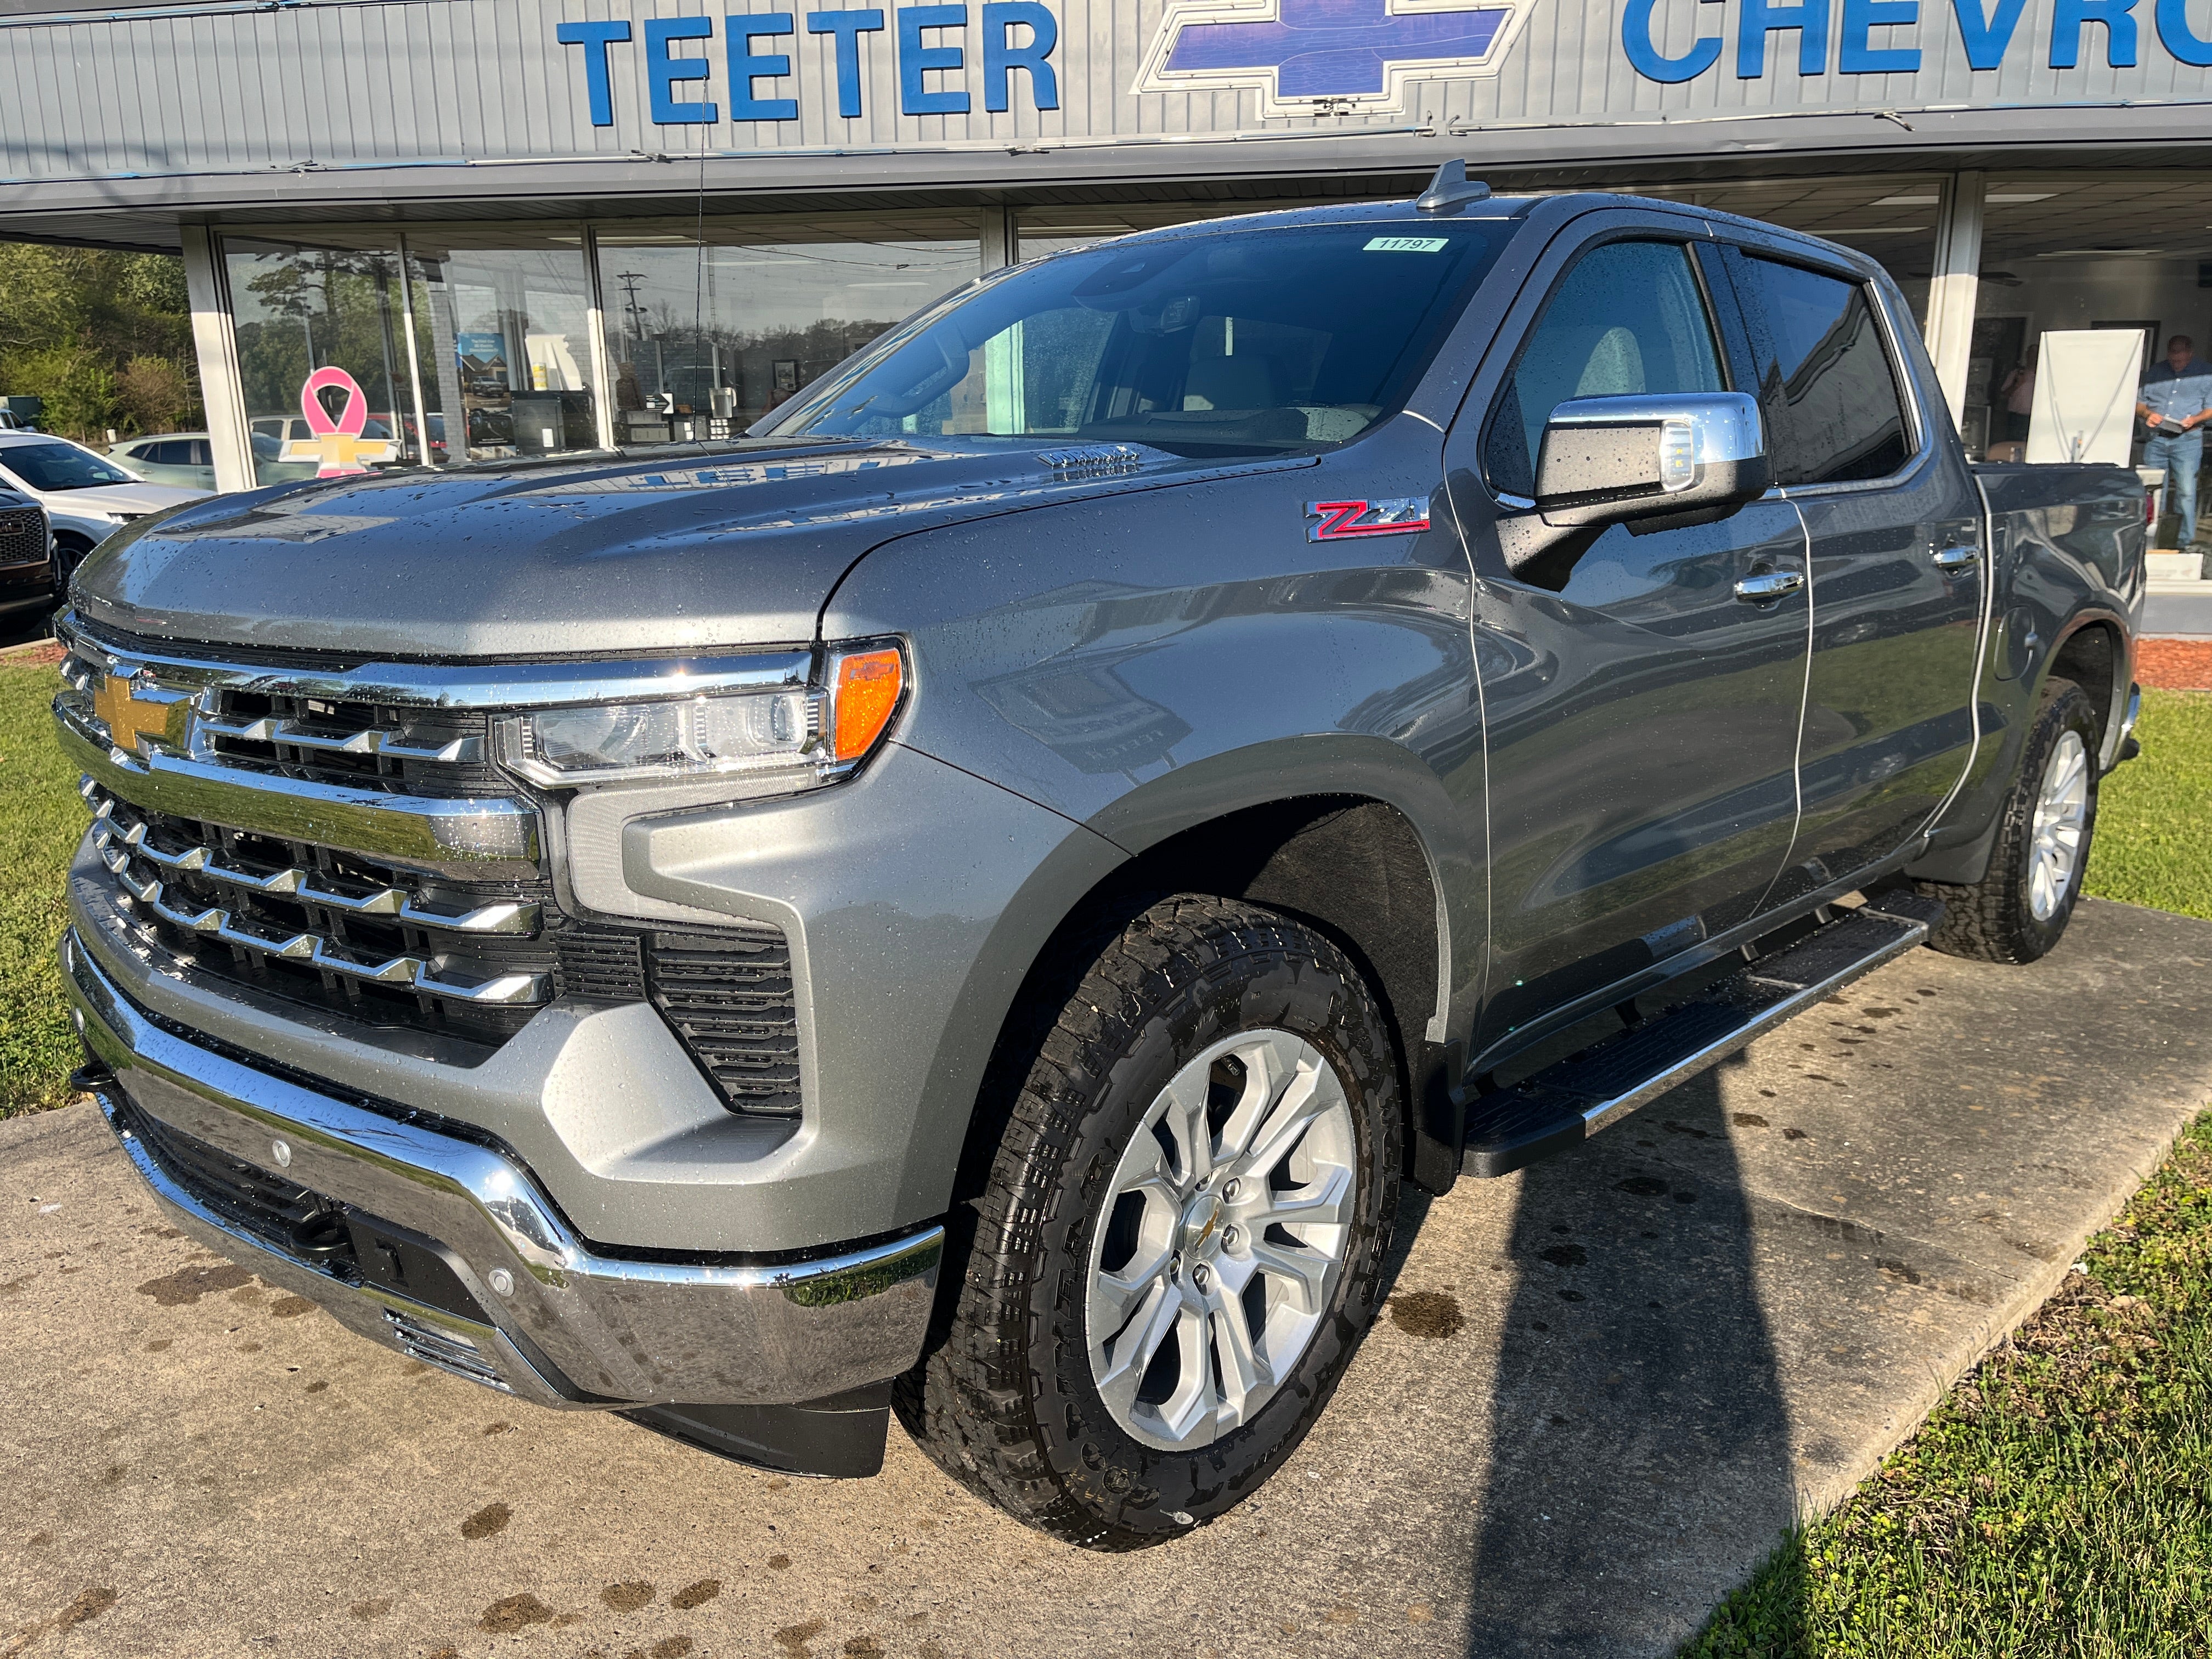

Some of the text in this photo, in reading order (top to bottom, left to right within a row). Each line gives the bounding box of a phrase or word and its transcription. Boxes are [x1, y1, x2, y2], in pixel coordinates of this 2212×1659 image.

[556, 1, 1059, 127] TEETER
[1379, 239, 1436, 249] 11797
[1305, 495, 1430, 543] Z71
